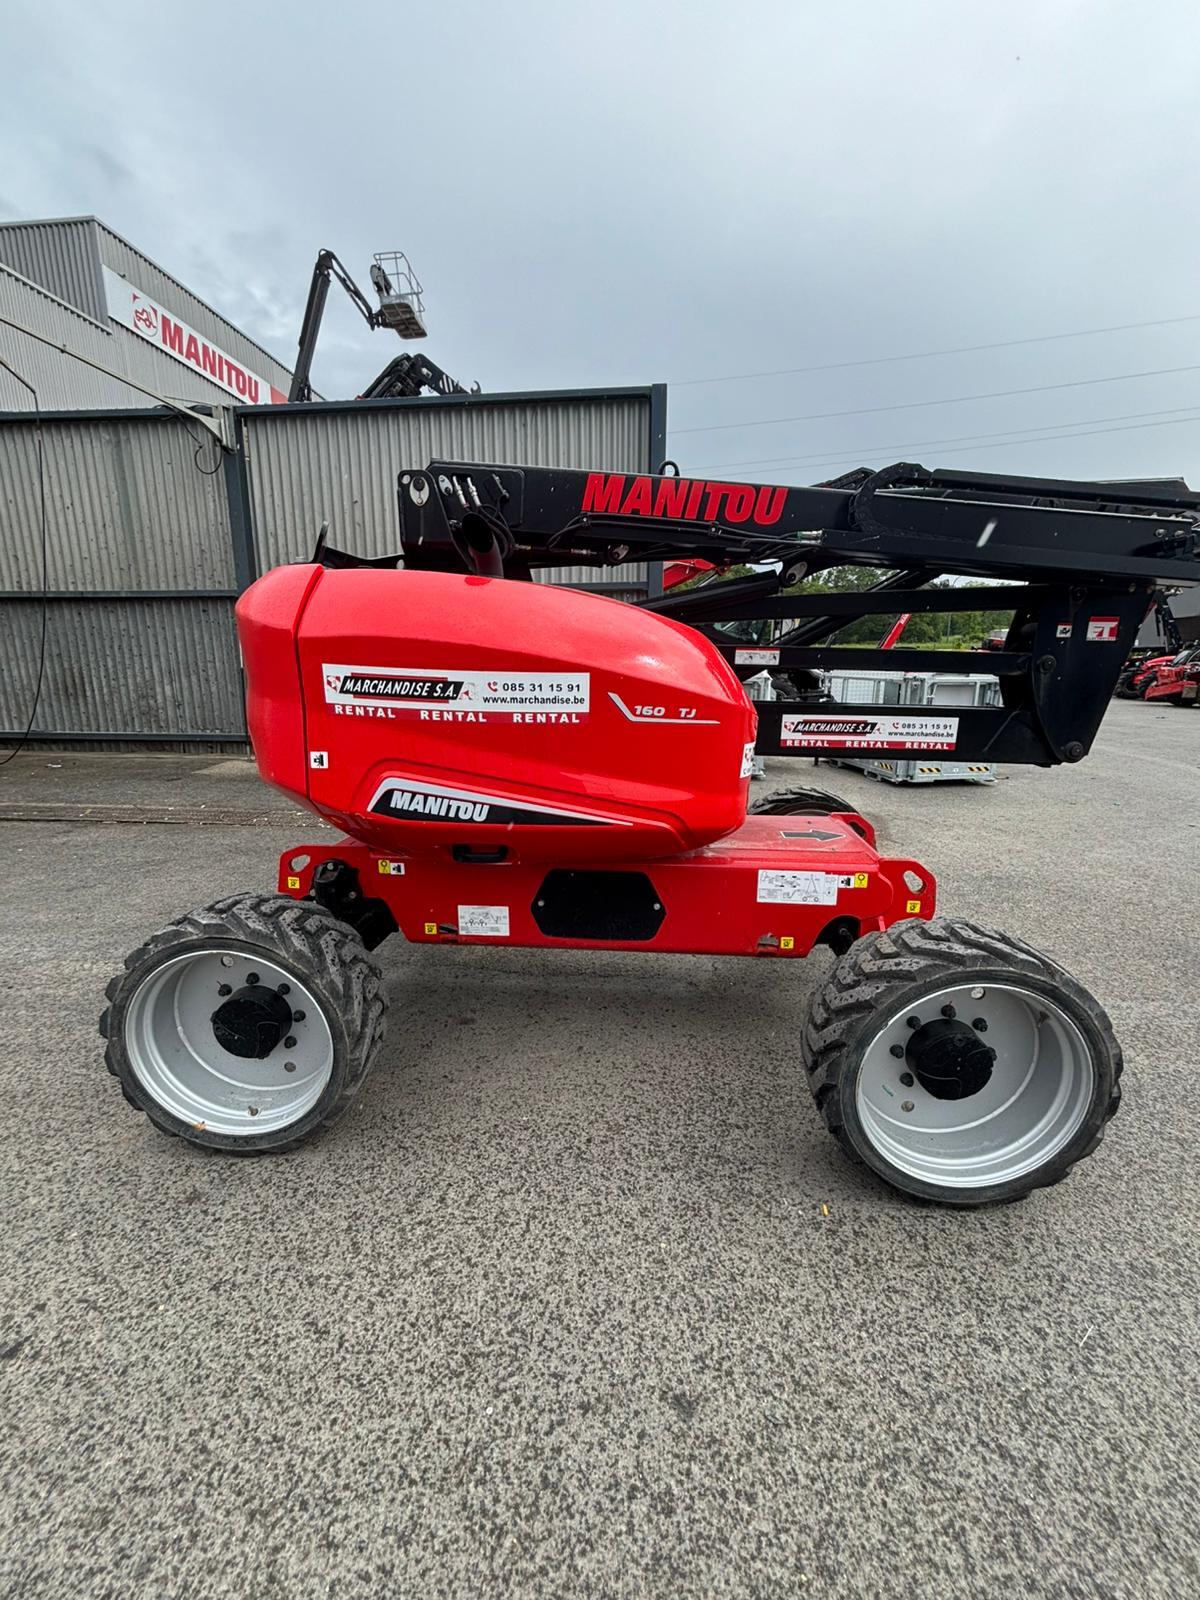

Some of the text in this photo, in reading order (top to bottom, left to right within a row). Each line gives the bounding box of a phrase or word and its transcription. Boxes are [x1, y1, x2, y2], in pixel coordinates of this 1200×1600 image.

[161, 313, 259, 404] MANITOU
[581, 473, 789, 525] MANITOU
[343, 678, 458, 699] MARCHANDISE S.A.
[502, 682, 581, 692] 085 31 15 91
[482, 694, 585, 705] www.marchandise.be
[334, 704, 580, 724] RENTAL RENTAL RENTAL
[634, 705, 697, 718] 160 TJ
[795, 721, 873, 733] MARCHANDISE S.A.
[943, 723, 952, 731] 91
[888, 730, 954, 738] www.marchandise.be
[786, 739, 949, 750] RENTAL RENTAL RENTAL
[389, 790, 490, 822] MANITOU
